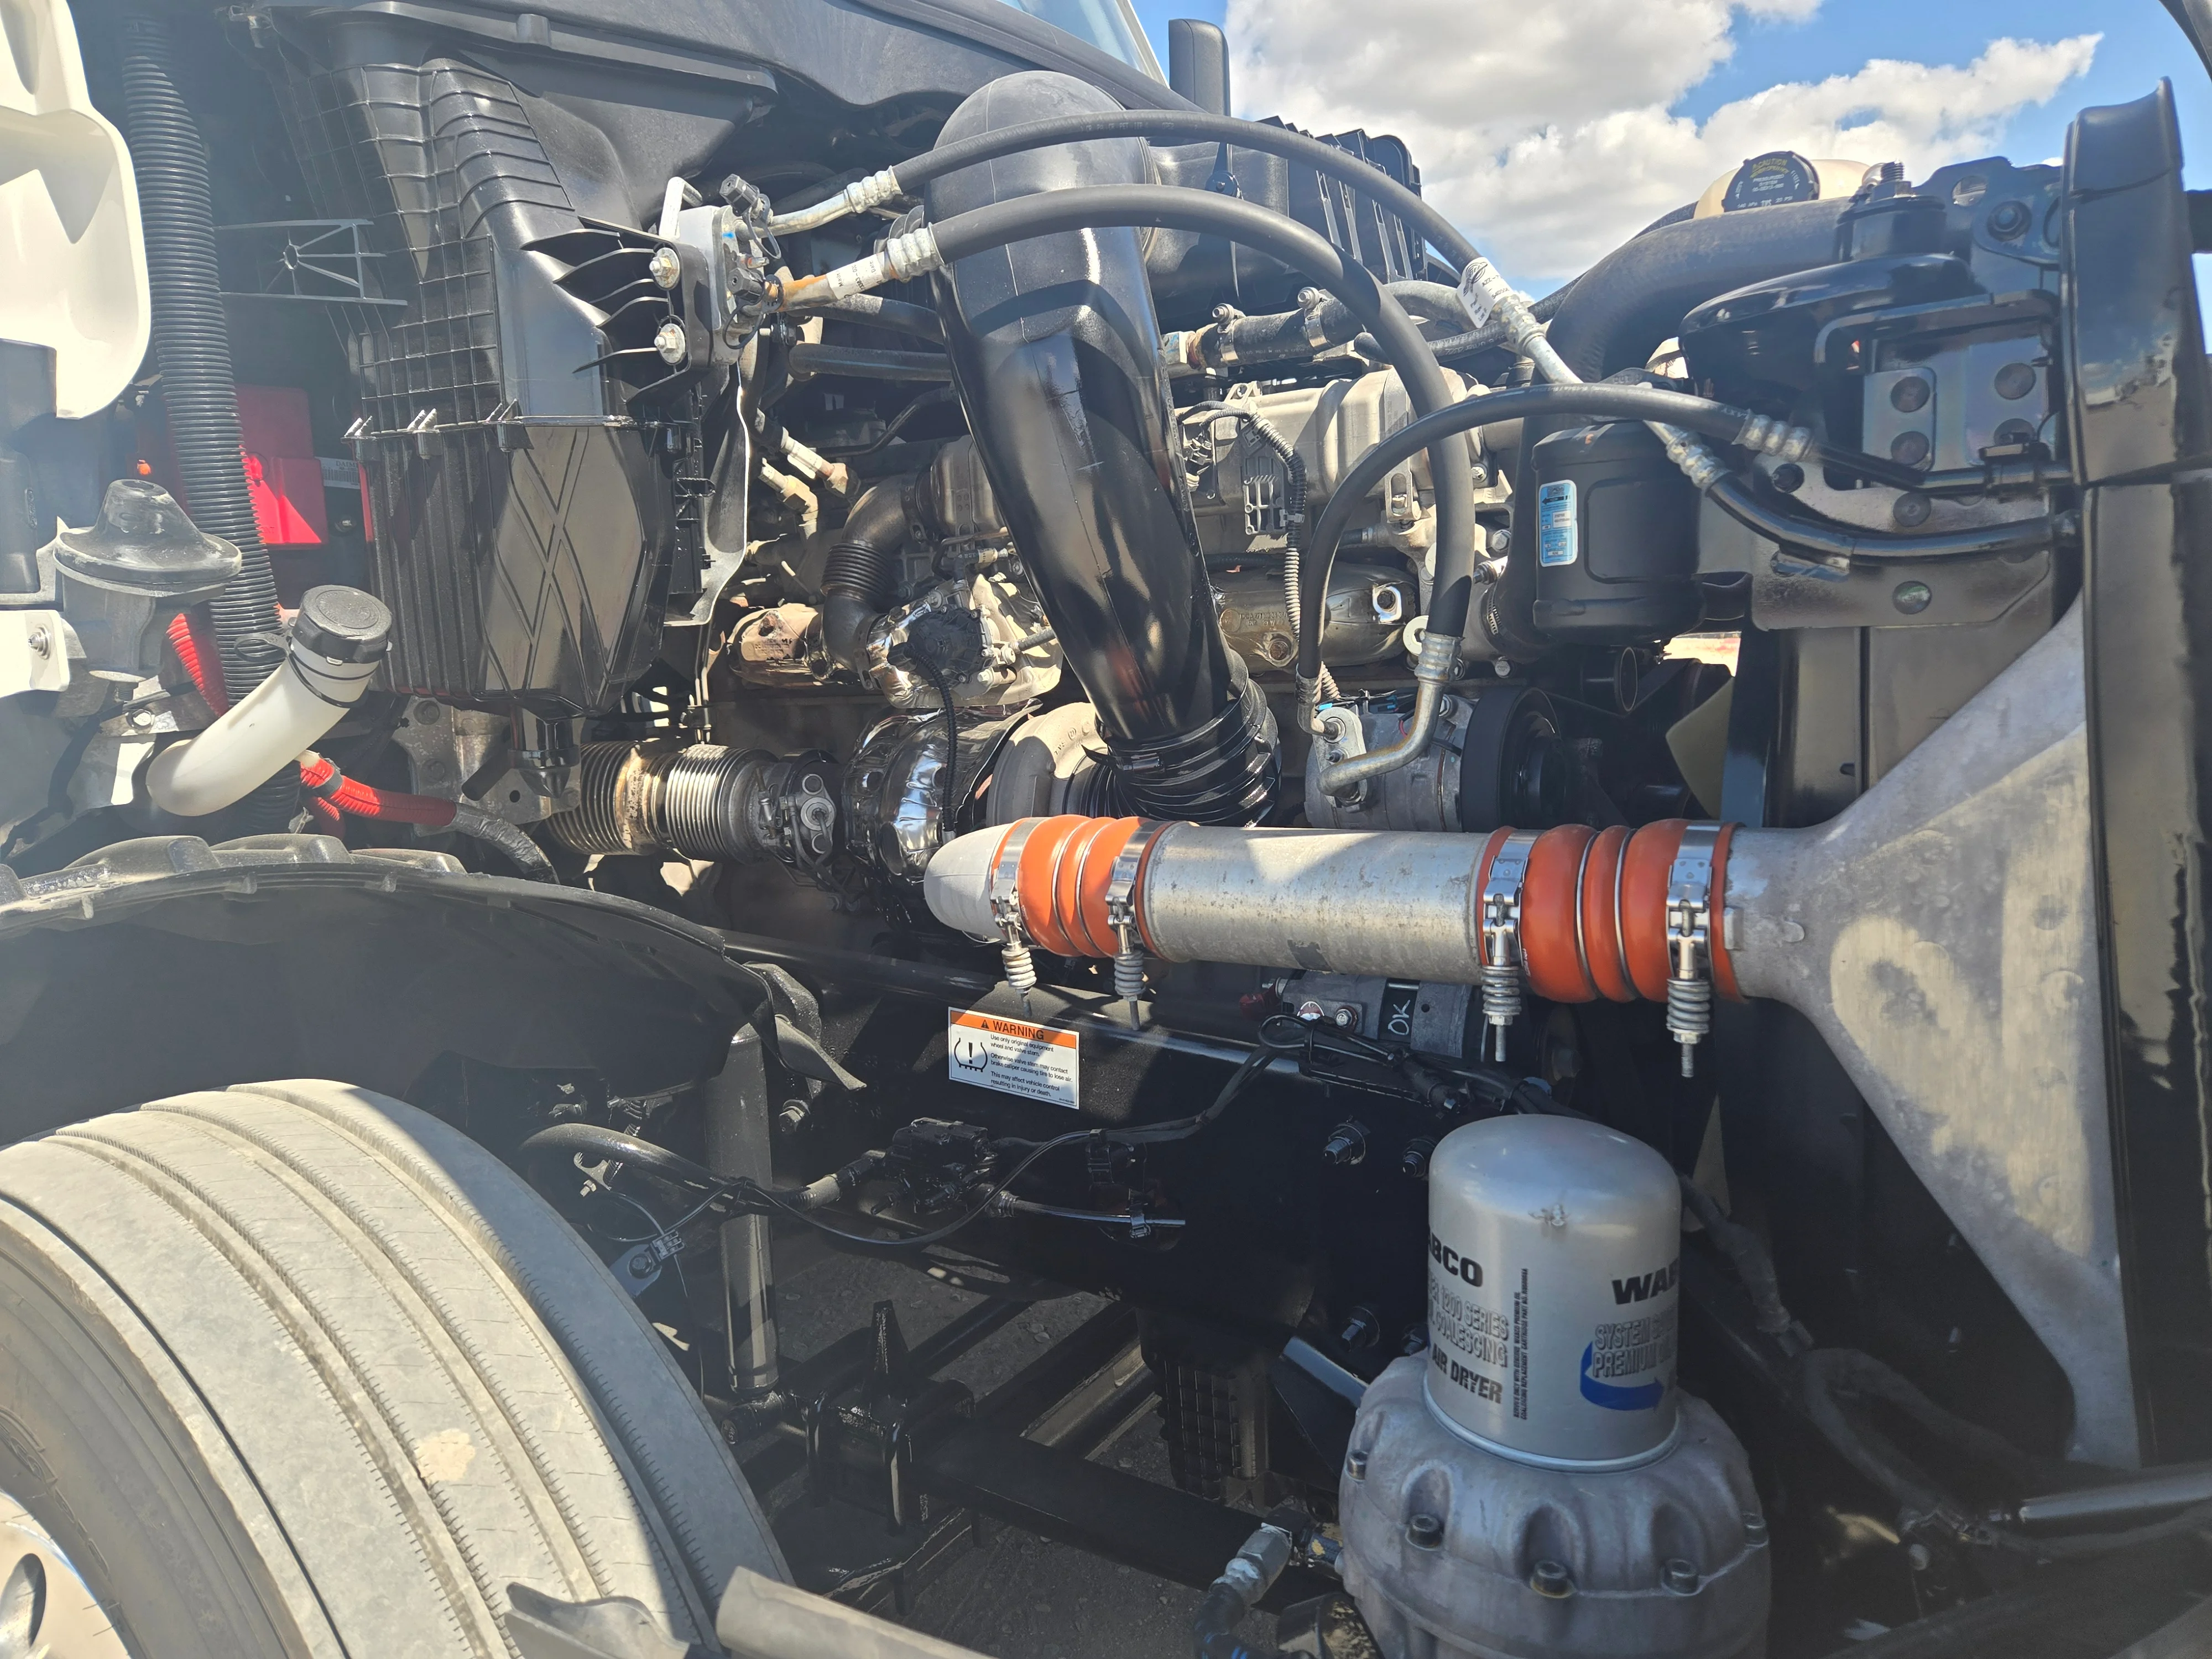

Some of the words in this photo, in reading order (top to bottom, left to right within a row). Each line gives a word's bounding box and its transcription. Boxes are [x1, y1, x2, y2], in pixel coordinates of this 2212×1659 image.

[993, 1020, 1044, 1040] WARNING
[1387, 999, 1411, 1036] OK
[1011, 1038, 1029, 1047] original
[1029, 1042, 1054, 1052] equipment
[990, 1052, 1013, 1062] Otherwise
[1040, 1063, 1050, 1072] may
[1050, 1066, 1068, 1074] contact
[1004, 1062, 1019, 1072] caliper
[1020, 1066, 1039, 1076] causing
[990, 1078, 1011, 1089] resulting
[1016, 1084, 1030, 1093] injury
[1011, 1076, 1025, 1084] affect
[1025, 1078, 1042, 1088] vehicle
[1042, 1082, 1060, 1091] control
[1428, 1231, 1483, 1287] BCO
[1441, 1285, 1463, 1322] 1200
[1464, 1300, 1509, 1342] SERIES
[1436, 1310, 1509, 1368] COALESCING
[1595, 1318, 1651, 1350] SYSTEM
[1432, 1342, 1448, 1372] AIR
[1451, 1359, 1503, 1404] DRYER
[1592, 1344, 1657, 1379] PREMIUM
